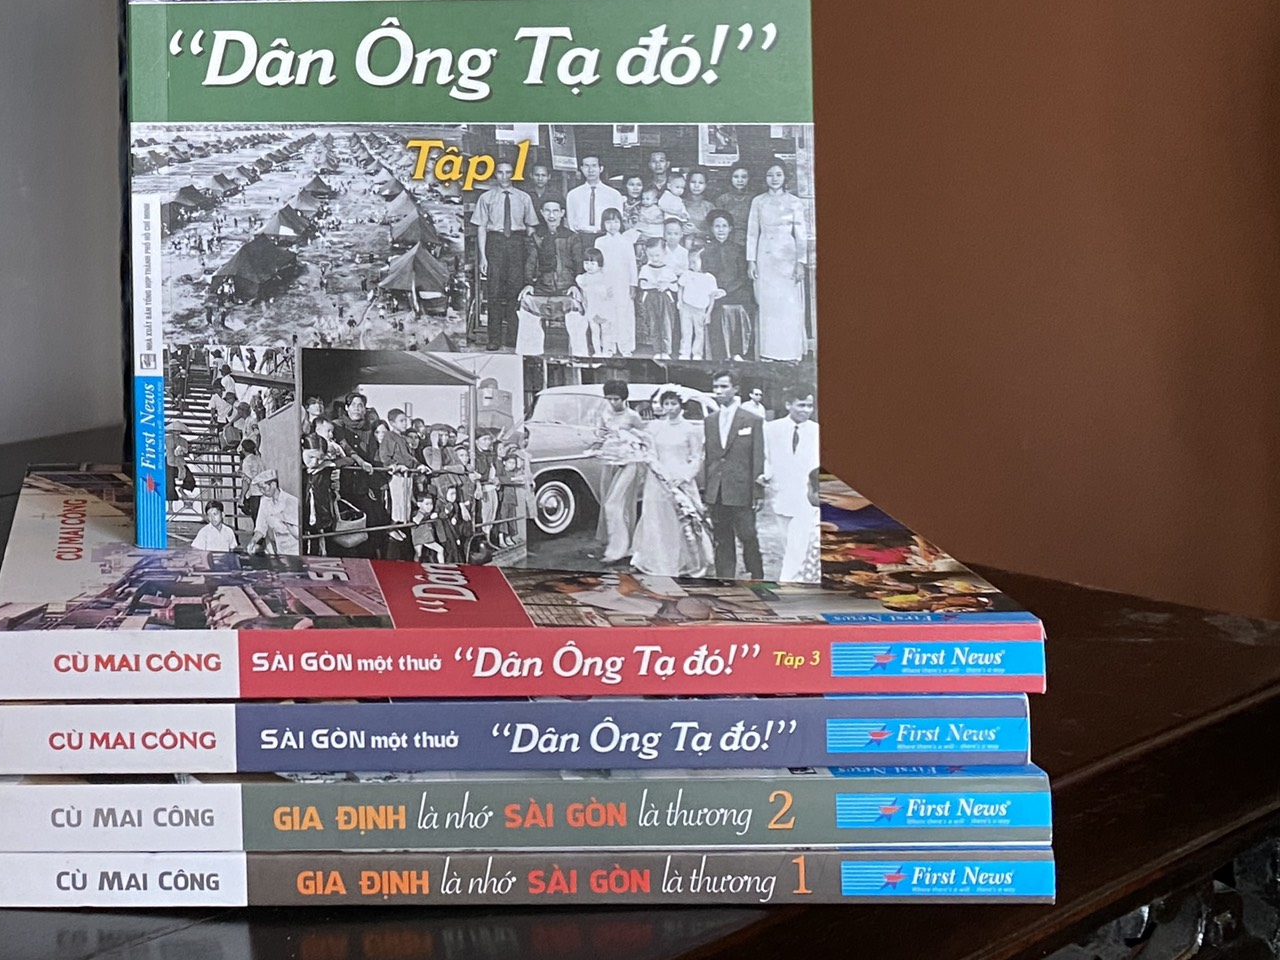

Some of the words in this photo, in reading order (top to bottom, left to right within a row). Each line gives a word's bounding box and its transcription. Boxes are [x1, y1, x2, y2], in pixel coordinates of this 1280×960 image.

[169, 28, 336, 87] “Dân
[354, 17, 498, 101] Ông
[514, 26, 601, 95] Tạ
[616, 22, 778, 87] đó!”
[406, 139, 494, 192] Tập
[510, 140, 529, 181] 1
[141, 431, 156, 469] First
[57, 499, 87, 525] CÔNG
[58, 527, 84, 545] MAI
[52, 546, 83, 560] CÙ
[54, 651, 88, 673] CÙ
[95, 655, 140, 672] MAI
[146, 651, 222, 672] CÔNG
[252, 651, 294, 672] SÀI
[300, 650, 352, 672] GÒN
[357, 655, 393, 674] một
[399, 654, 442, 672] thuở
[454, 647, 543, 677] “Dân
[552, 641, 625, 684] Ông
[633, 646, 676, 680] Tạ
[683, 644, 761, 676] đó!”
[773, 651, 805, 668] Tập
[810, 650, 821, 665] 3
[901, 647, 946, 665] First
[48, 729, 83, 751] CÙ
[89, 732, 135, 750] MAI
[141, 728, 216, 751] CÔNG
[261, 728, 304, 750] SÀI
[311, 727, 365, 750] GÒN
[371, 733, 408, 752] một
[414, 729, 459, 749] thuở
[492, 723, 580, 754] “Dân
[589, 717, 662, 759] Ông
[670, 722, 712, 756] Tạ
[719, 720, 797, 751] đó!”
[897, 724, 940, 742] First
[51, 805, 81, 828] CÙ
[93, 808, 143, 828] MAI
[153, 804, 214, 827] CÔNG
[273, 807, 324, 830] GIA
[335, 806, 406, 835] ĐỊNH
[418, 791, 438, 829] là
[444, 791, 493, 830] nhớ
[505, 798, 554, 828] SÀI
[566, 797, 627, 827] GÒN
[638, 788, 660, 828] là
[666, 788, 752, 836] thương
[768, 791, 795, 830] 2
[906, 799, 951, 817] First
[56, 869, 87, 891] CÙ
[98, 872, 147, 891] MAI
[158, 868, 219, 891] CÔNG
[296, 871, 346, 894] GIA
[359, 871, 429, 900] ĐỊNH
[440, 856, 461, 894] là
[468, 856, 517, 894] nhớ
[528, 864, 577, 894] SÀI
[589, 864, 650, 894] GÒN
[661, 854, 683, 893] là
[689, 855, 776, 902] thương
[792, 855, 812, 894] 1
[911, 866, 957, 885] First
[962, 866, 1013, 885] News
